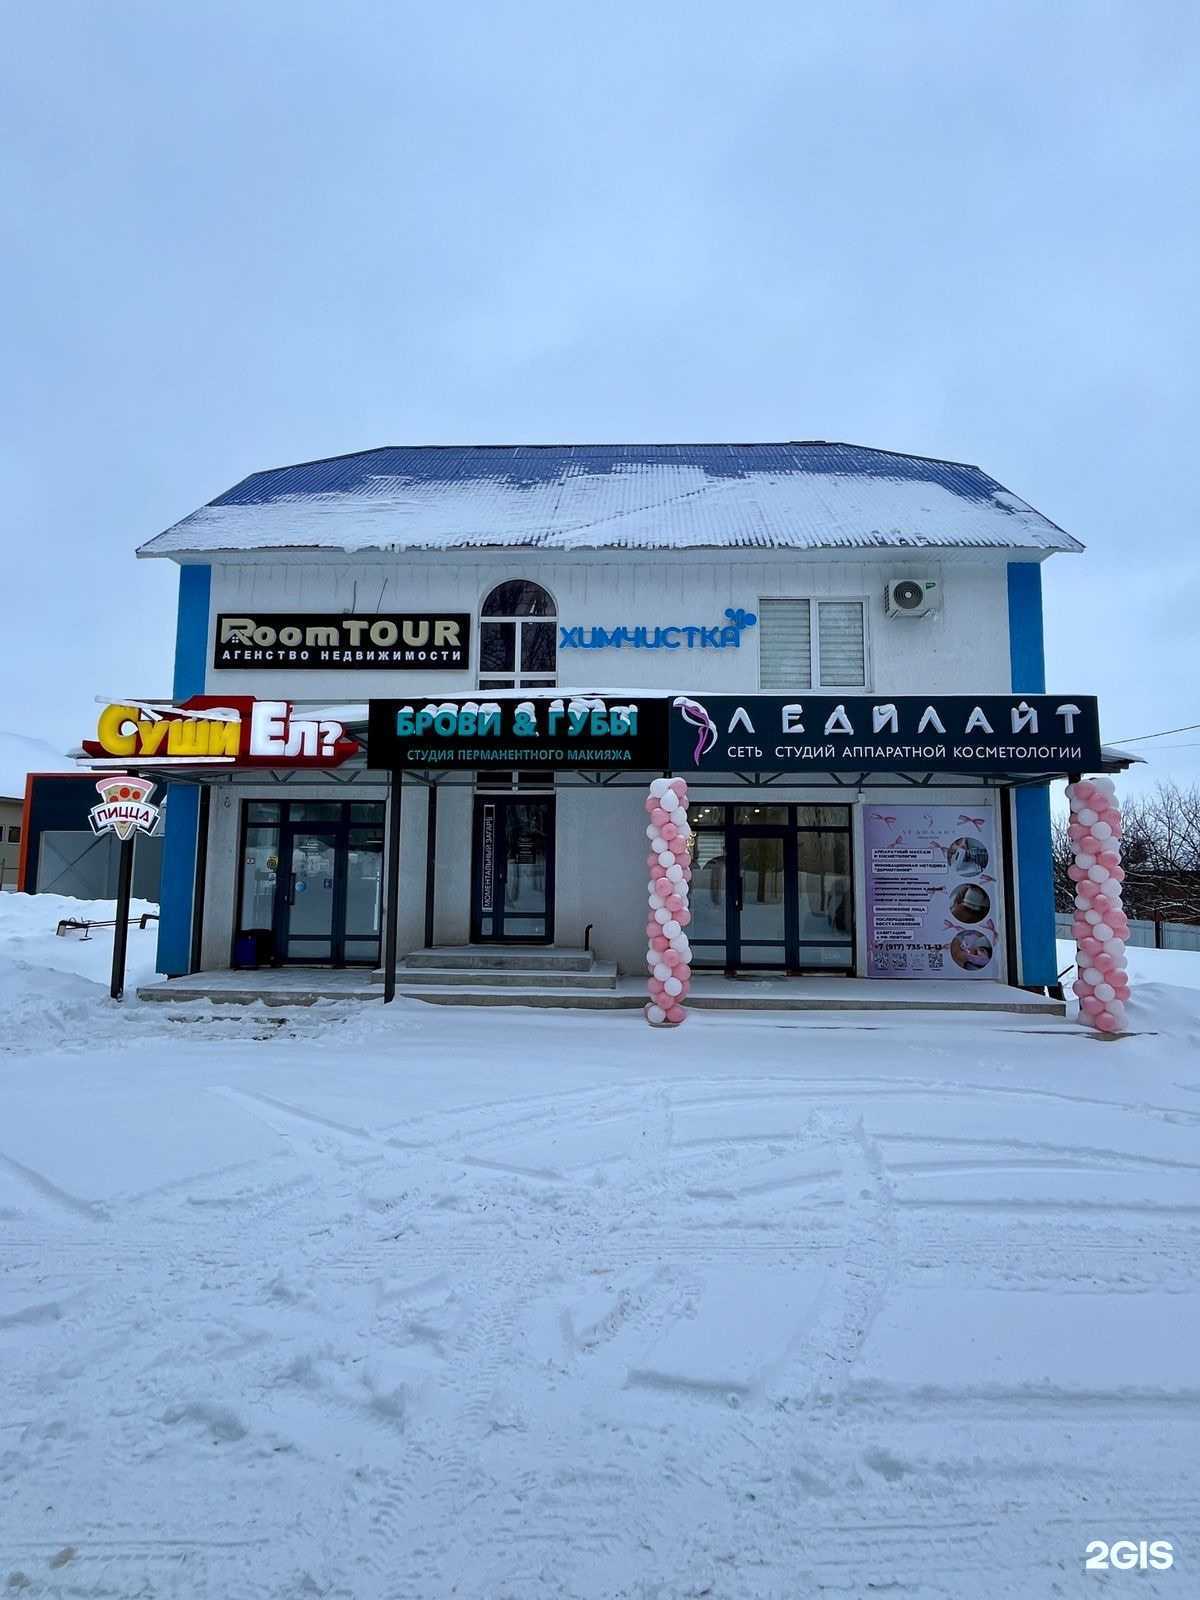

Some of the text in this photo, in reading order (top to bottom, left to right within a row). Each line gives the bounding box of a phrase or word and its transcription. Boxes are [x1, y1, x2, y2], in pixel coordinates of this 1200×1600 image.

[559, 626, 741, 649] ХИМЧИСТКА
[222, 650, 461, 662] АГЕНСТВО НЕДВИЖИМОСТИ
[396, 706, 638, 737] БРОВИ & ГУБЫ
[407, 750, 632, 763] СТУДИЯ ПЕРМАНЕНТНОГО МАКИЯЖА
[727, 745, 1082, 760] СЕТЬ СТУДИЙ АППАРАТНОЙ КОСМЕТОЛОГИИ
[97, 808, 150, 824] ПИЦЦА
